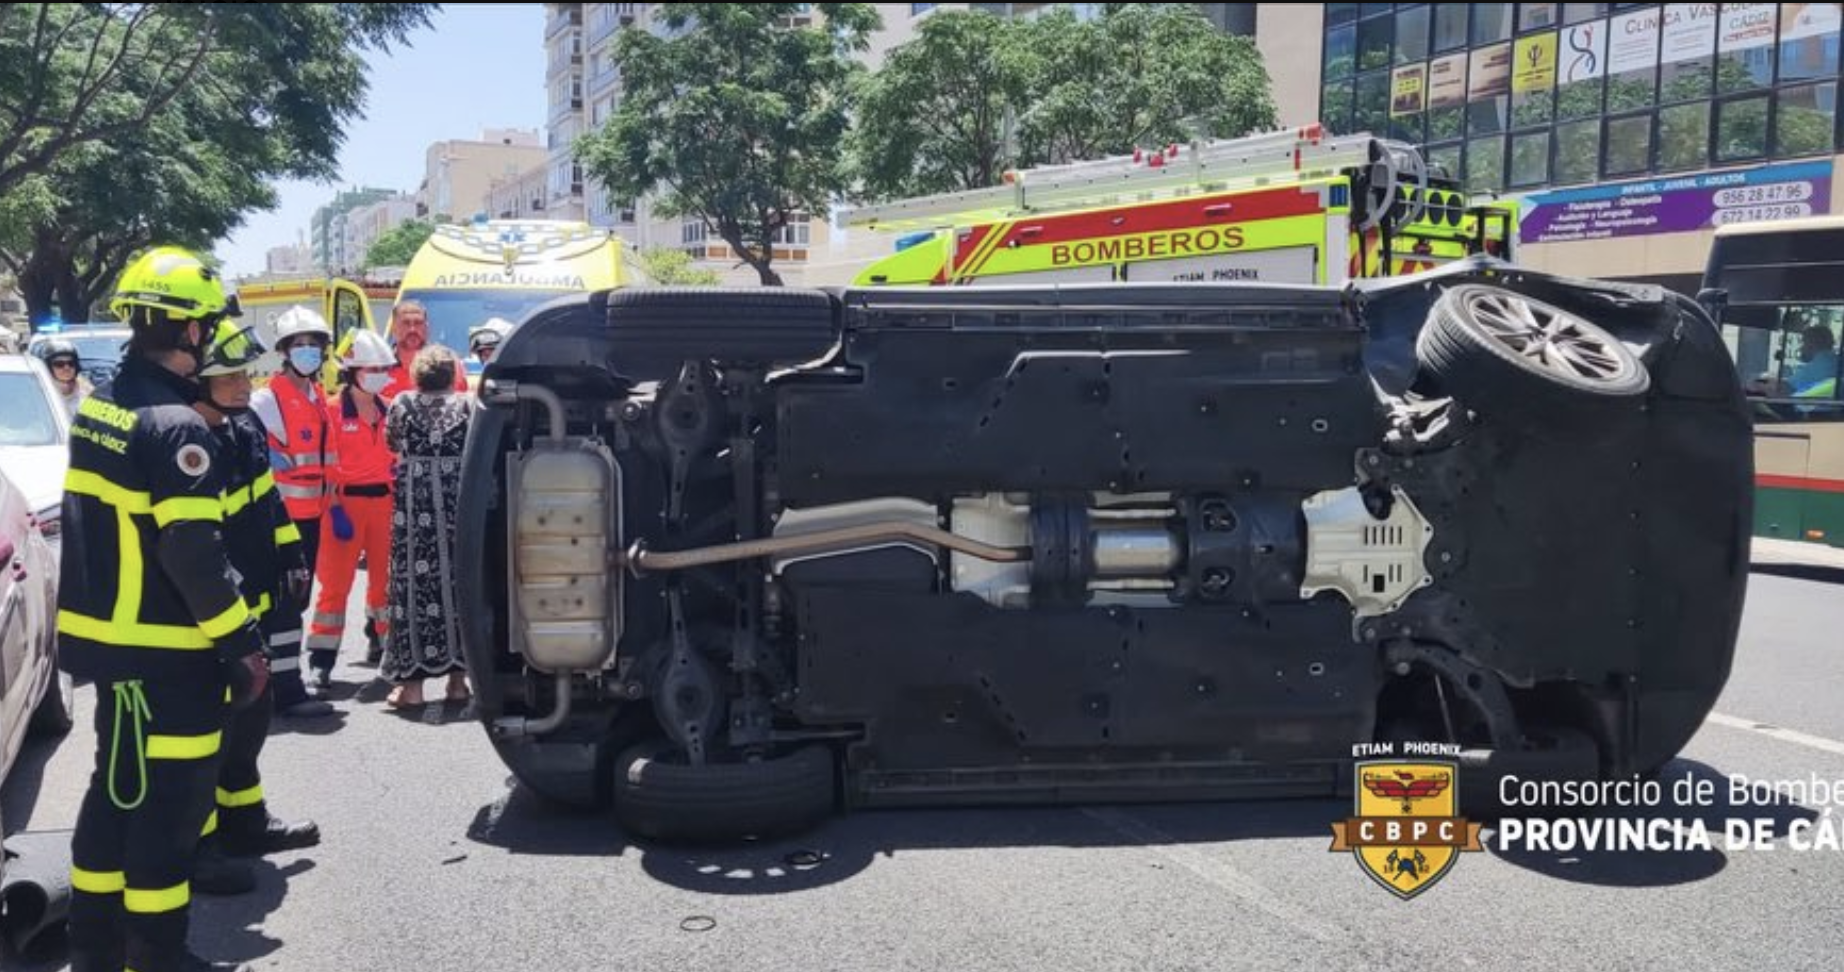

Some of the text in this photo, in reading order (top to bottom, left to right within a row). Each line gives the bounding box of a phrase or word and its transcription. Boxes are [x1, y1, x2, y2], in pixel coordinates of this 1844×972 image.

[1625, 11, 1681, 34] CLINCA
[1052, 227, 1245, 265] BOMBEROS
[1213, 268, 1258, 280] PHOENIX
